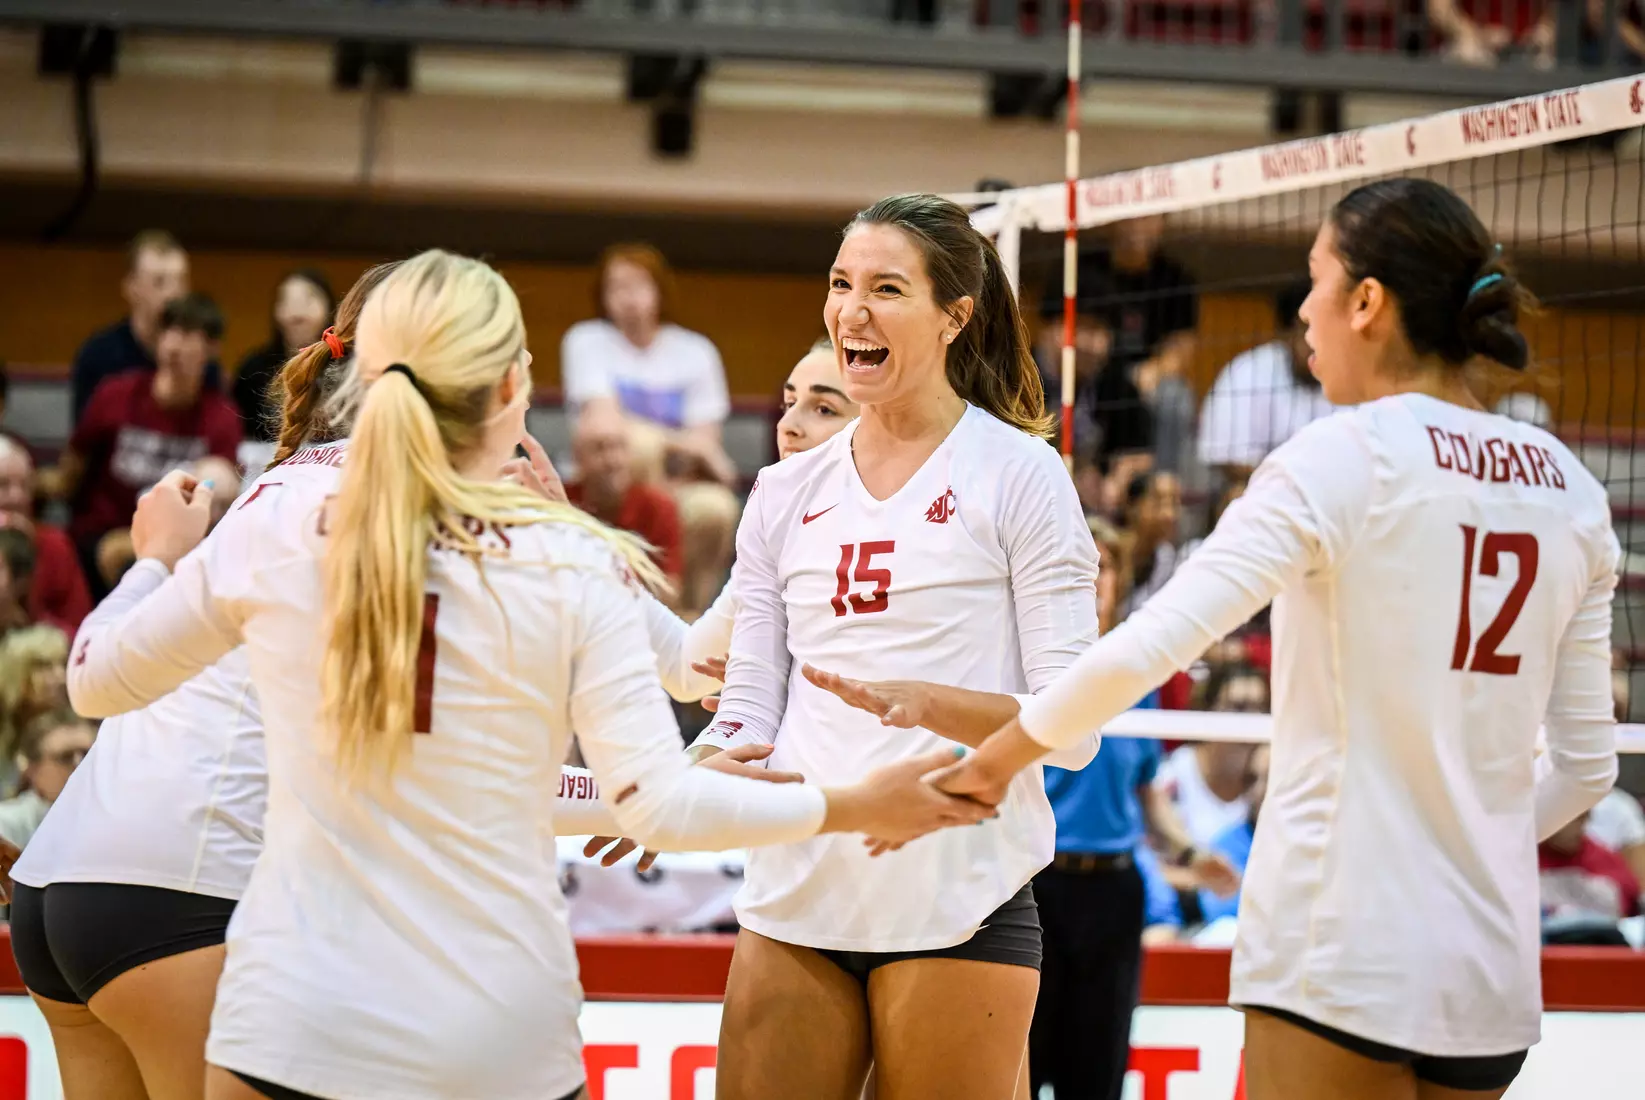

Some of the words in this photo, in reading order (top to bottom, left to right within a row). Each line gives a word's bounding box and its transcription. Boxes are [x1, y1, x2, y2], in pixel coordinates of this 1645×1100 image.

[1459, 101, 1539, 144] WASHINGTON
[1543, 91, 1582, 130] STATE
[1425, 424, 1567, 491] COUGARS
[830, 540, 896, 618] 15
[1450, 522, 1539, 676] 12
